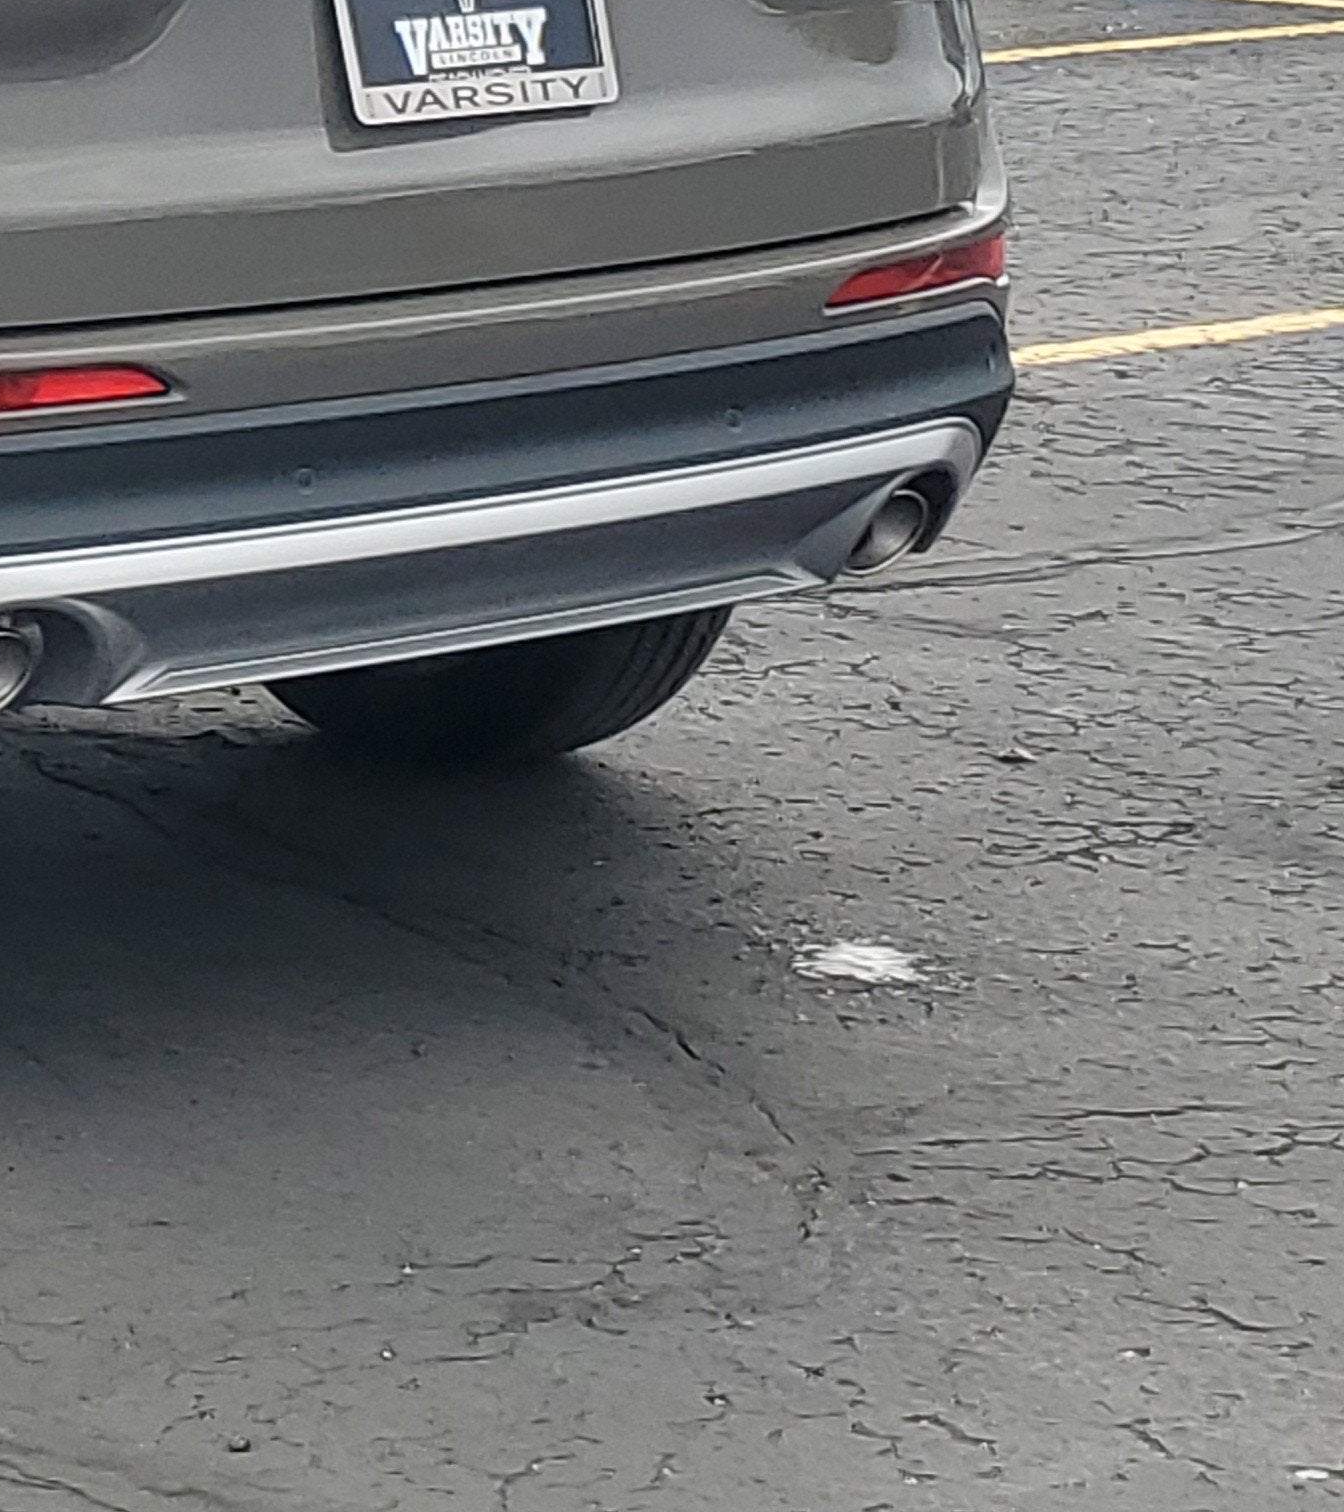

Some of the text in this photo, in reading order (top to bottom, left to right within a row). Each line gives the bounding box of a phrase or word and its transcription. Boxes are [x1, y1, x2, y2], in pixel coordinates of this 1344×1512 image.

[393, 6, 547, 76] VARSITY
[437, 49, 514, 66] LINCOLN
[382, 75, 588, 115] VARSITY
